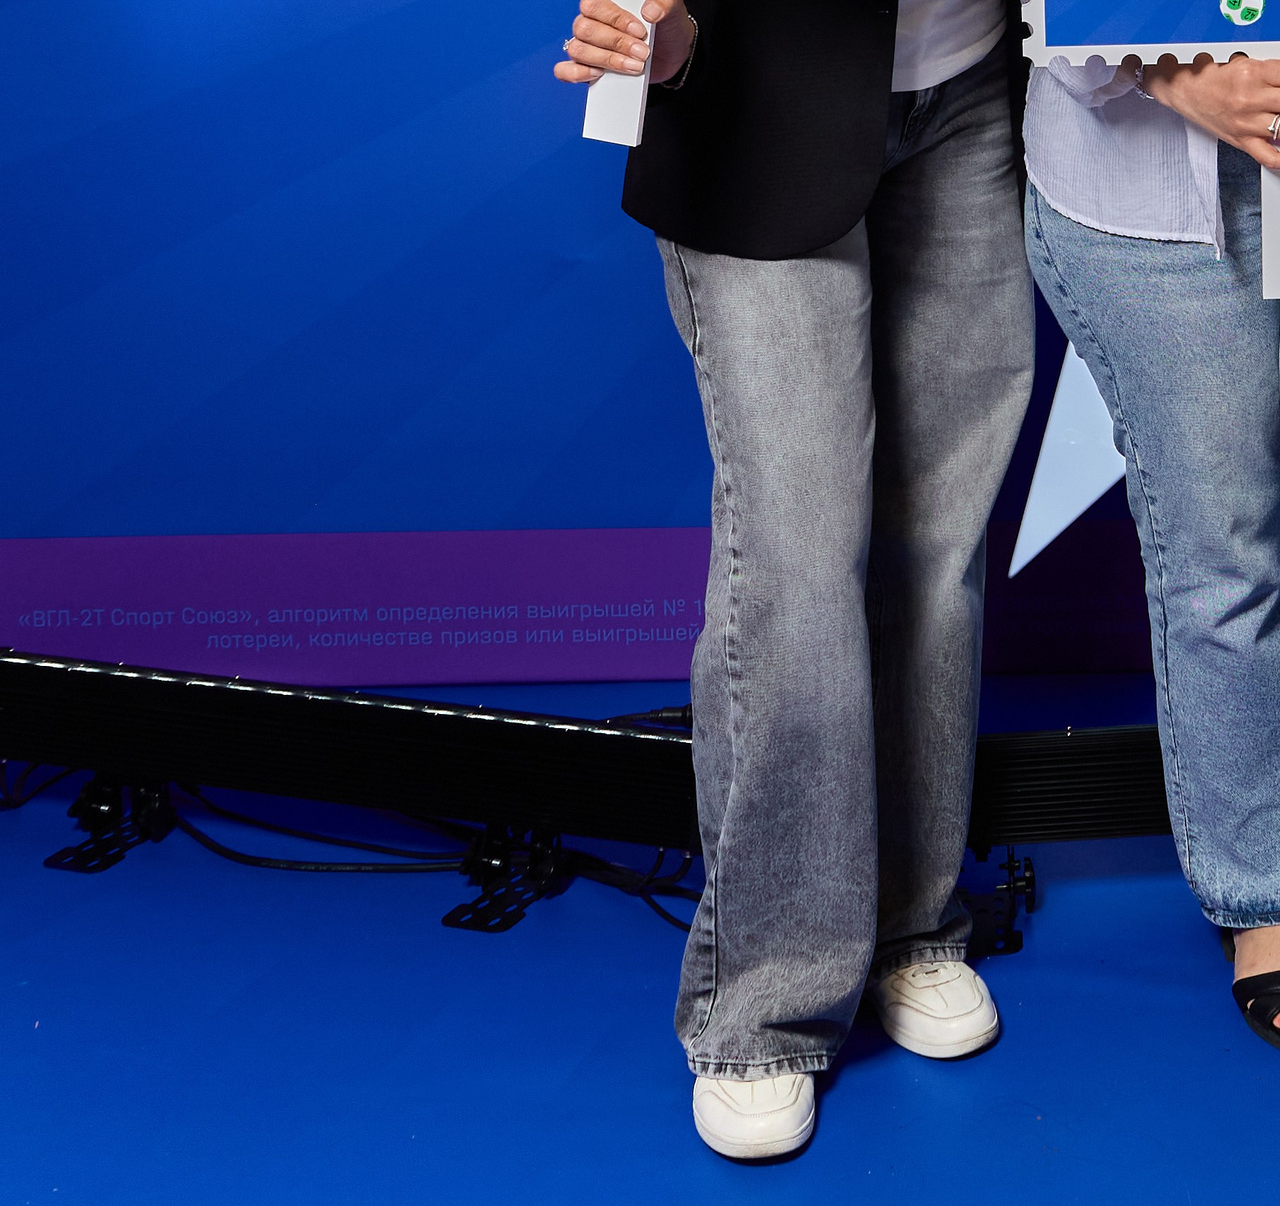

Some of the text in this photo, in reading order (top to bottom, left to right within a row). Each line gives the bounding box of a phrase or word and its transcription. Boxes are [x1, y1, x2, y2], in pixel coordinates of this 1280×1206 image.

[18, 608, 105, 627] «ВГЛ-2Т
[111, 607, 174, 629] Спорт
[181, 607, 260, 626] Союз»,
[268, 606, 368, 626] алгоритм
[376, 604, 518, 624] определения
[527, 599, 655, 622] выигрышей
[663, 599, 685, 616] №
[206, 623, 700, 652] лотереи, количестве призов или выигрышей
